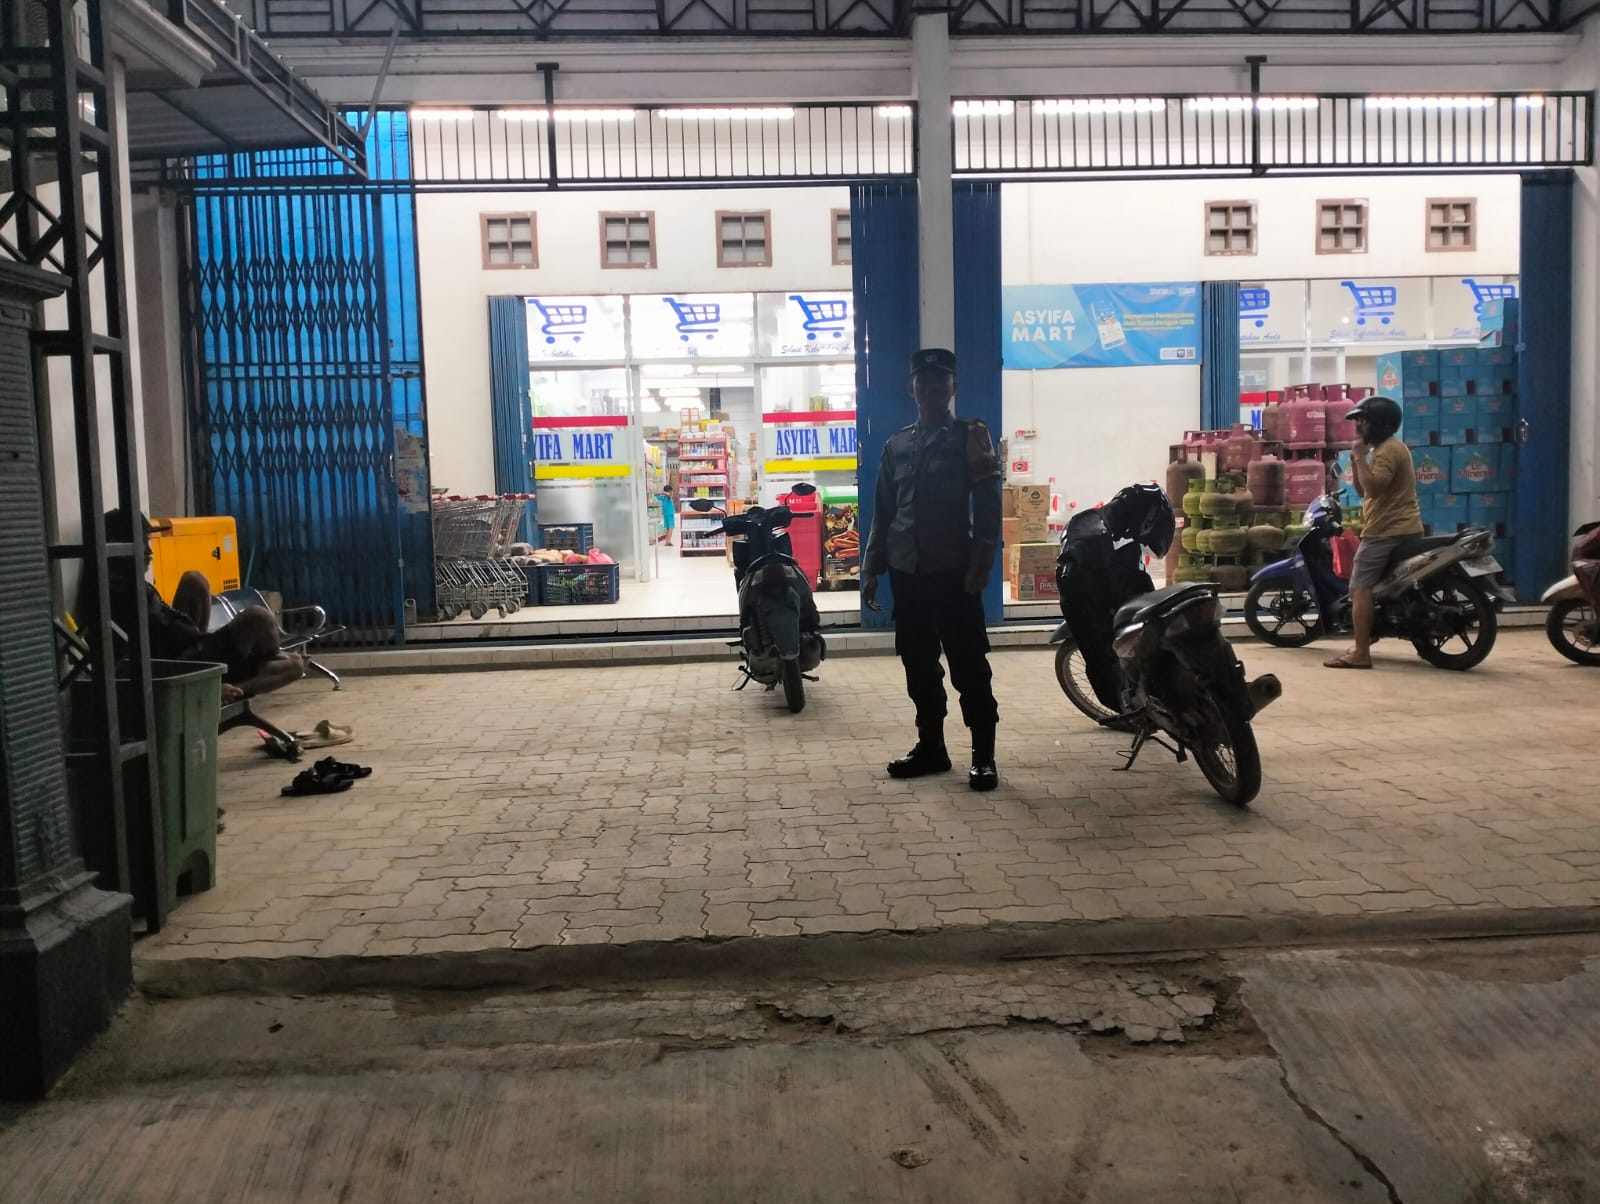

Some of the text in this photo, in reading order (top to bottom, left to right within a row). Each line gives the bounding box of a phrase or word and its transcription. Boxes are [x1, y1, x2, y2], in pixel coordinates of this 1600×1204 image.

[1011, 309, 1075, 325] ASYIFA
[1011, 325, 1075, 343] MART
[572, 432, 614, 460] MART
[776, 428, 820, 456] ASYIFA
